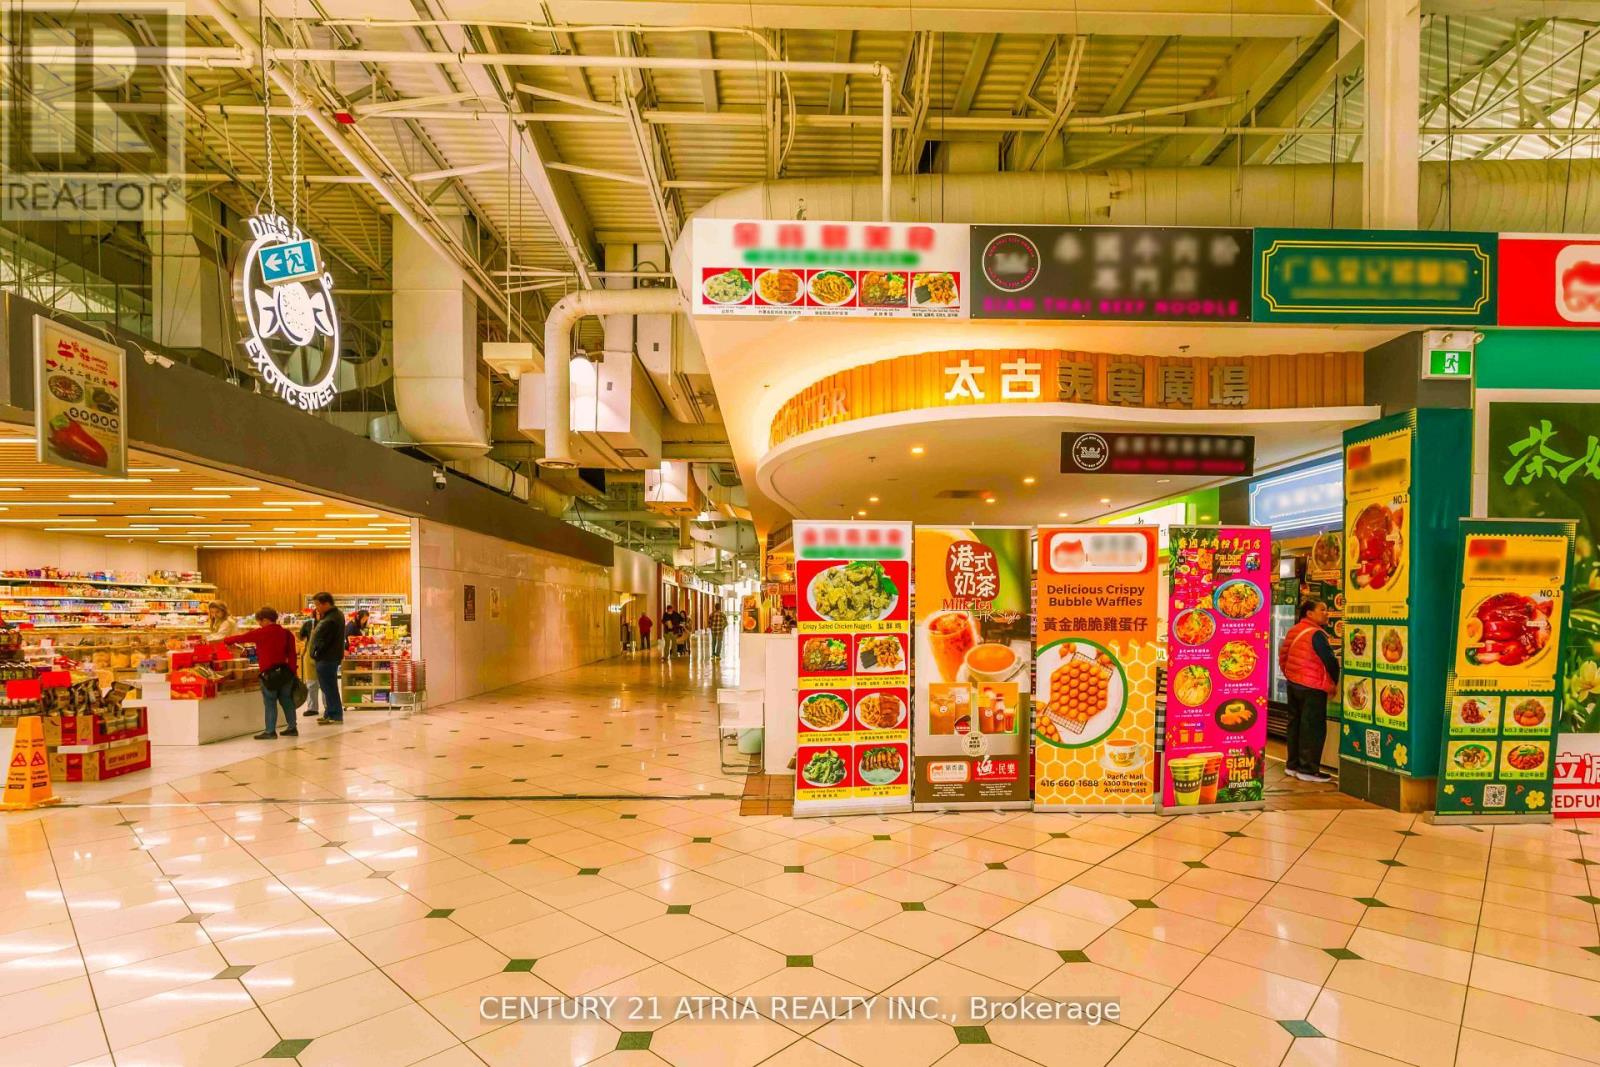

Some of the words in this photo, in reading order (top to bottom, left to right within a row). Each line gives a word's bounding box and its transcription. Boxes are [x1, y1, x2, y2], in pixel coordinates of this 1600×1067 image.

[248, 213, 290, 241] DING
[245, 337, 297, 405] EXOTIC
[298, 377, 338, 410] SWEET
[949, 544, 993, 572] 港式
[954, 572, 997, 598] 奶茶
[1047, 584, 1103, 594] Delicious
[1106, 585, 1145, 596] Crispy
[1540, 589, 1560, 598] NO.1
[1049, 597, 1093, 606] Bubble
[1095, 597, 1143, 606] Waffles
